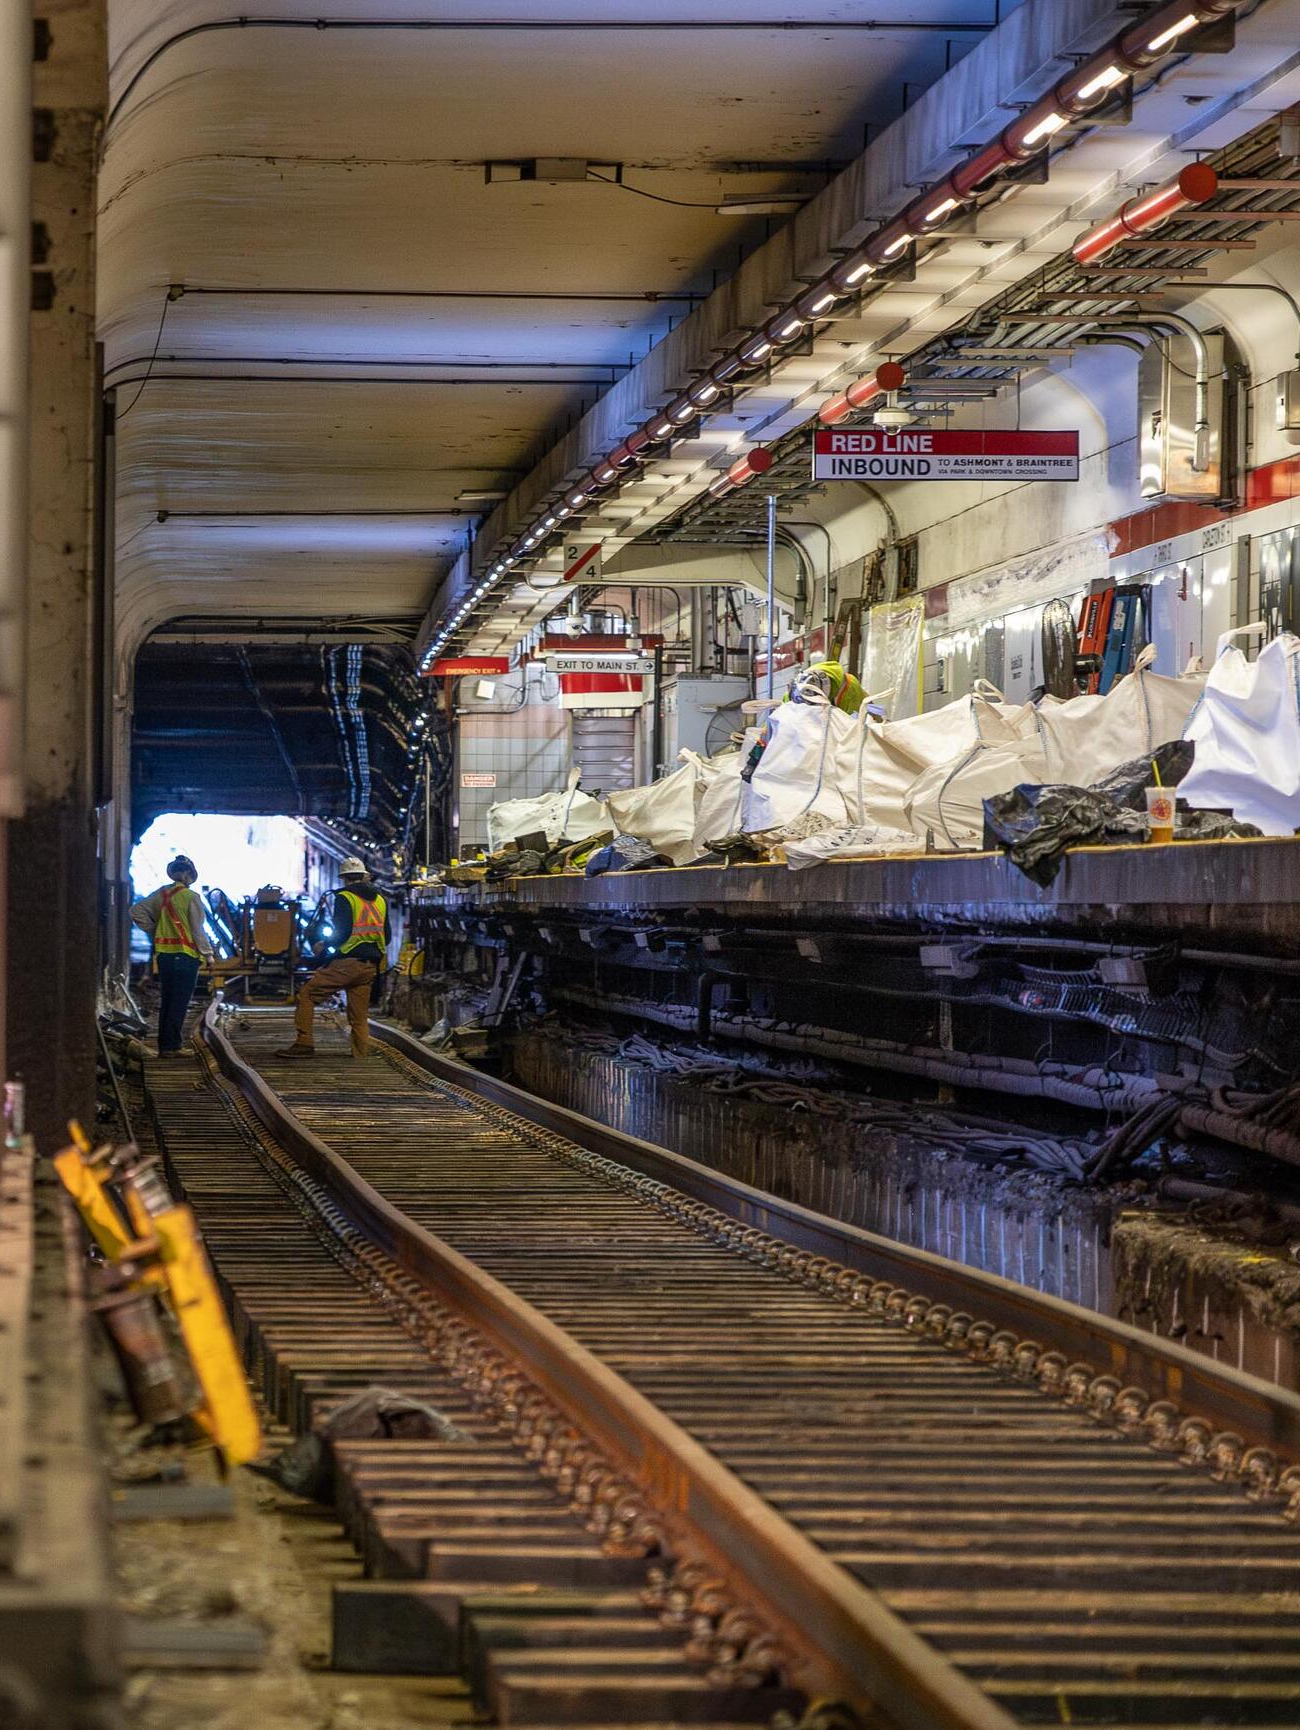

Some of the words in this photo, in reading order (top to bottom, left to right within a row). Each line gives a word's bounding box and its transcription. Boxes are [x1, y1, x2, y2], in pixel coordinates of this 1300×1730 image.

[831, 434, 876, 453] RED
[882, 434, 933, 453] LINE
[831, 458, 931, 476] INBOUND
[938, 459, 950, 467] TO
[953, 459, 1004, 467] ASHMONT
[1007, 459, 1013, 467] &
[1016, 459, 1073, 467] BRAINTREE
[568, 546, 578, 559] 2
[586, 565, 596, 578] 4
[557, 661, 577, 669] EXIT
[581, 661, 593, 669] TO
[597, 661, 622, 670] MAIN
[626, 662, 640, 671] ST.
